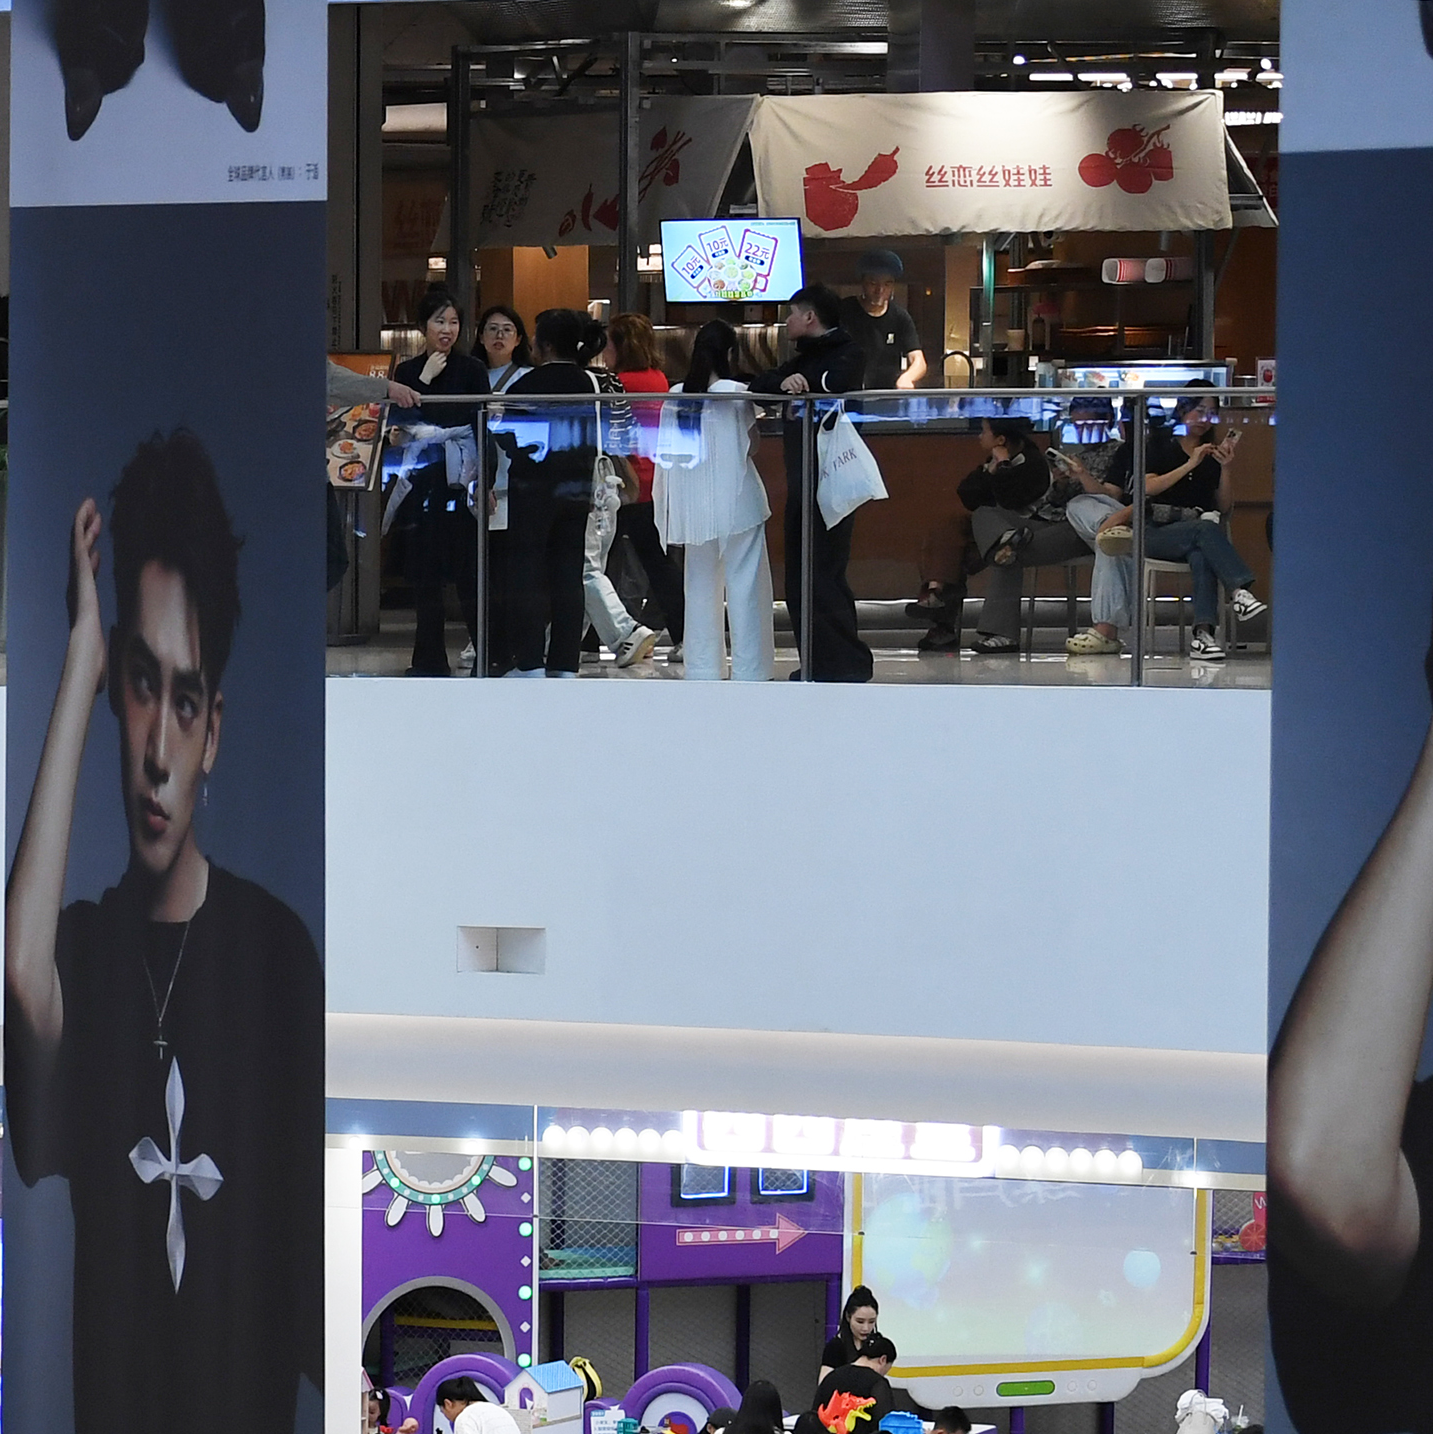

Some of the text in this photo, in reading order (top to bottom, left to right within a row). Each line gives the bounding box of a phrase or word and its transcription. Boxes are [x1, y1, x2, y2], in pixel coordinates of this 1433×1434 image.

[925, 164, 1053, 188] 丝恋丝娃娃
[707, 237, 730, 252] 10元
[744, 242, 770, 260] 22元
[681, 255, 702, 275] 10元
